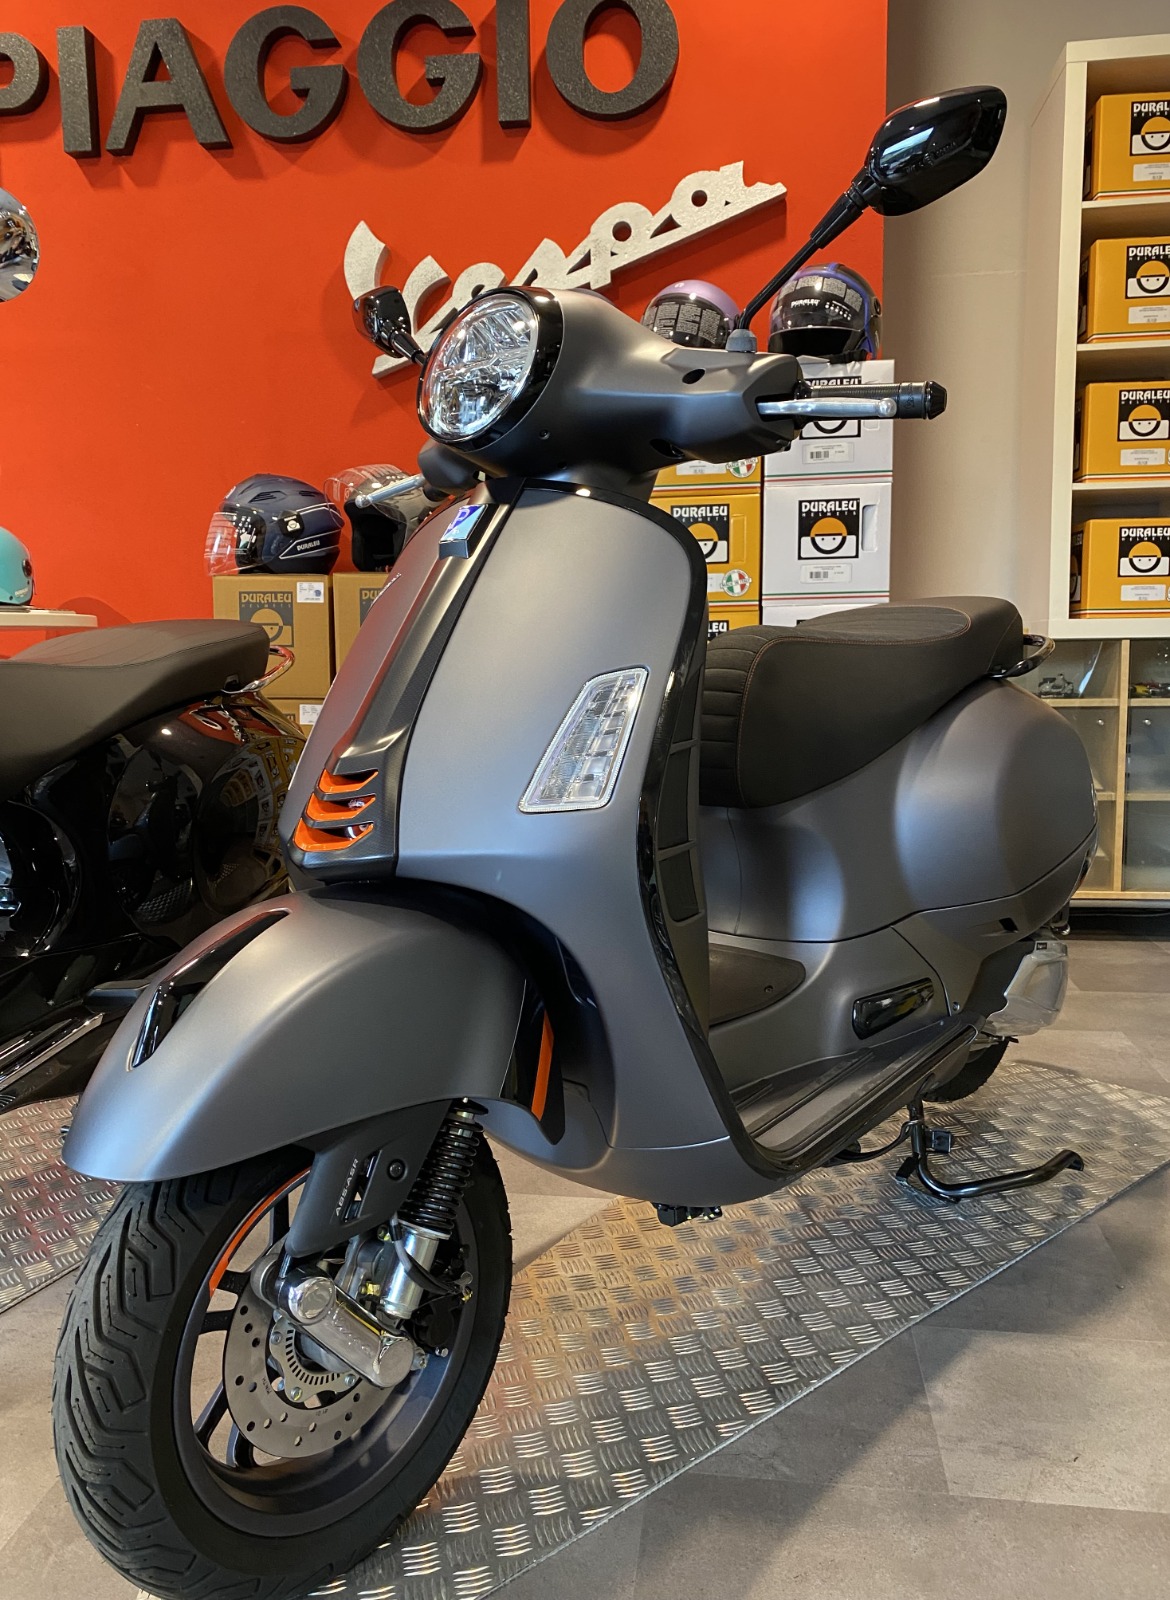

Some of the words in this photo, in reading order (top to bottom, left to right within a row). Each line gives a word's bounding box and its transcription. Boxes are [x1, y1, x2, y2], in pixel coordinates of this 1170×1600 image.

[0, 0, 679, 157] PIAGGIO
[672, 505, 728, 518] DURALEU
[801, 500, 857, 513] DURALEU
[241, 593, 292, 604] DURALEU
[335, 1158, 359, 1217] ABS-ASR
